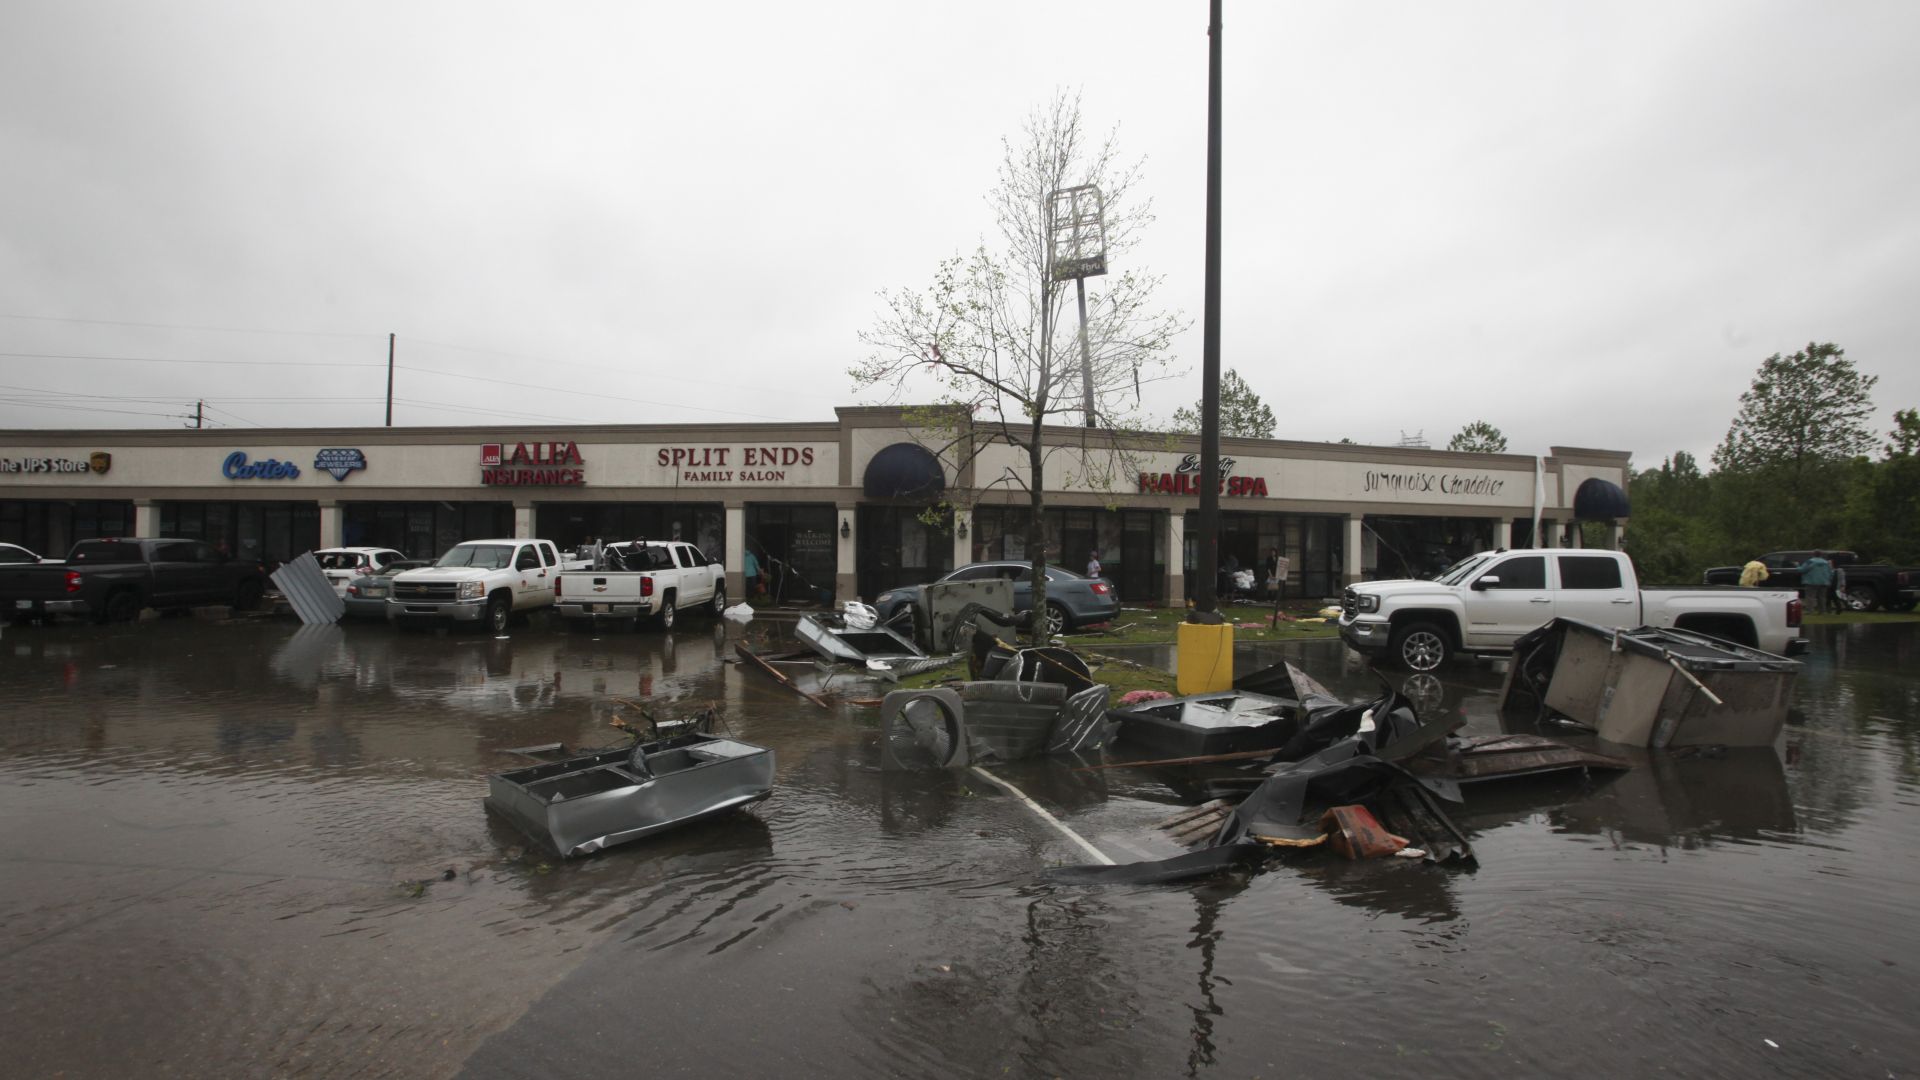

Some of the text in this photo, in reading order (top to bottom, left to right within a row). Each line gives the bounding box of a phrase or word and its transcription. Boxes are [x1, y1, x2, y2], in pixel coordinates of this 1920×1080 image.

[0, 457, 88, 473] he UPS Store
[223, 451, 301, 480] Carter
[657, 447, 814, 467] SPLIT ENDS
[684, 470, 785, 482] FAMILY SALON
[1227, 476, 1269, 497] SPA
